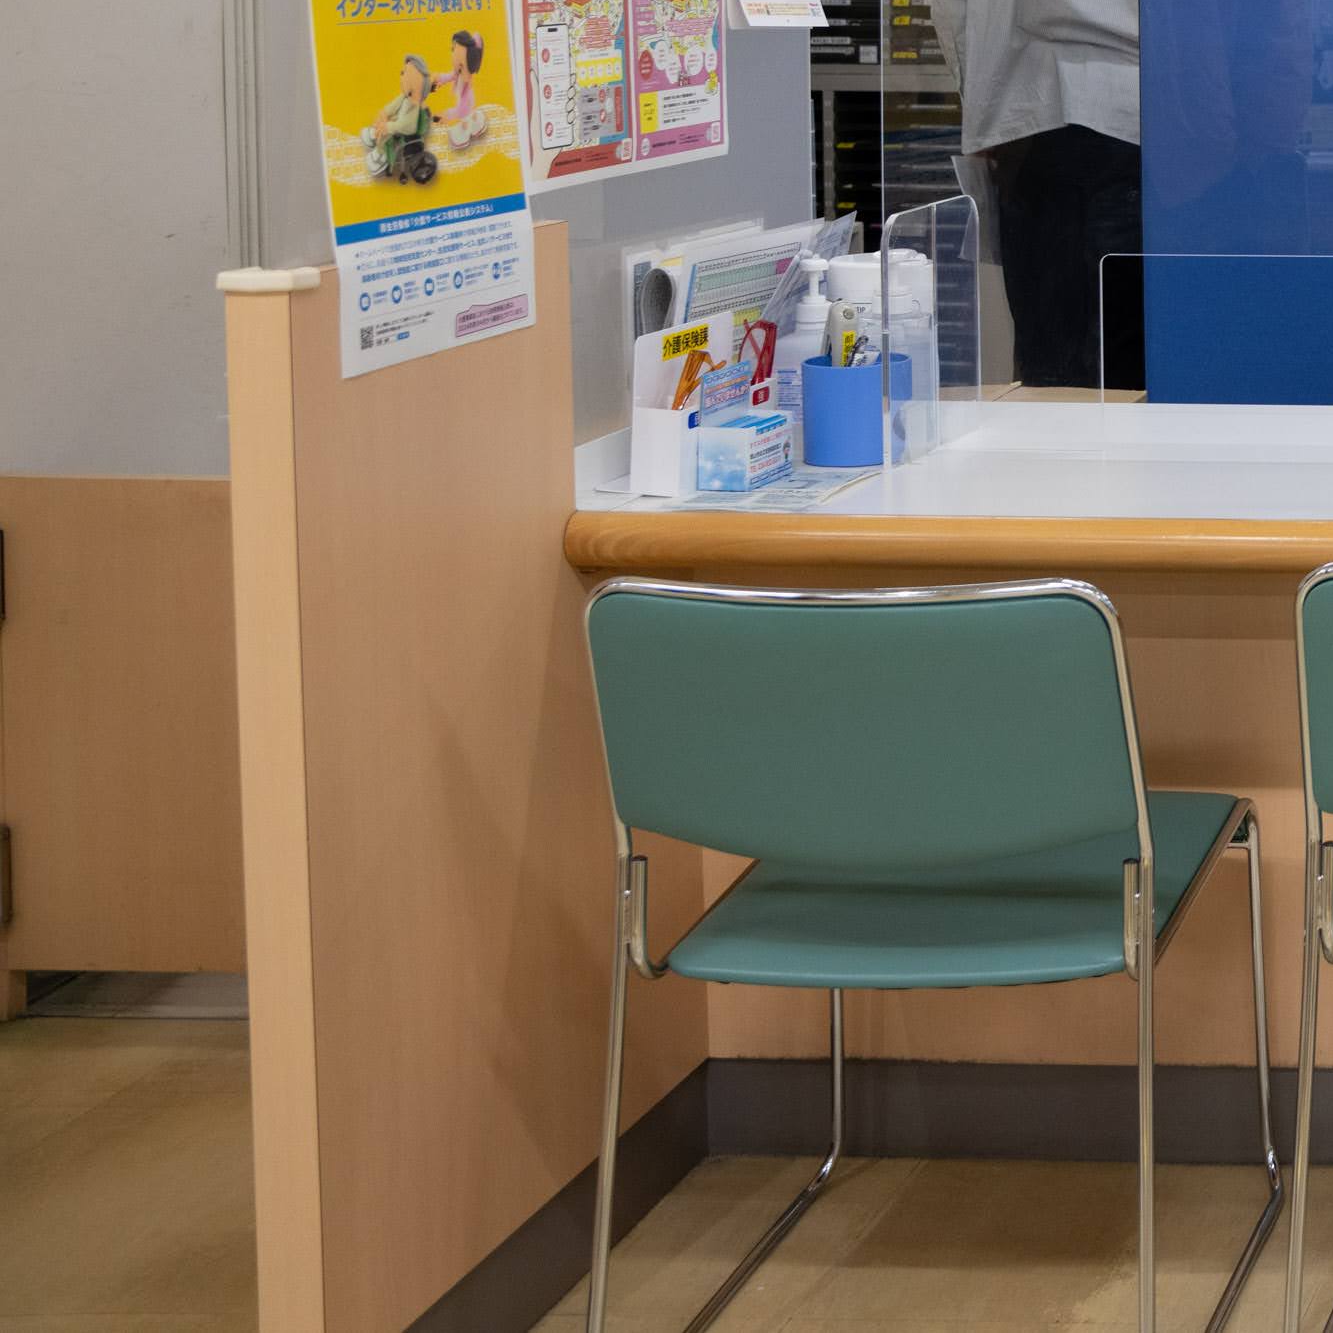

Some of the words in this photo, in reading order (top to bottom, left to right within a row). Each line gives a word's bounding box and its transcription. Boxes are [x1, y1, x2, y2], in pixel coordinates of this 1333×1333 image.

[662, 327, 709, 358] 介護保険課
